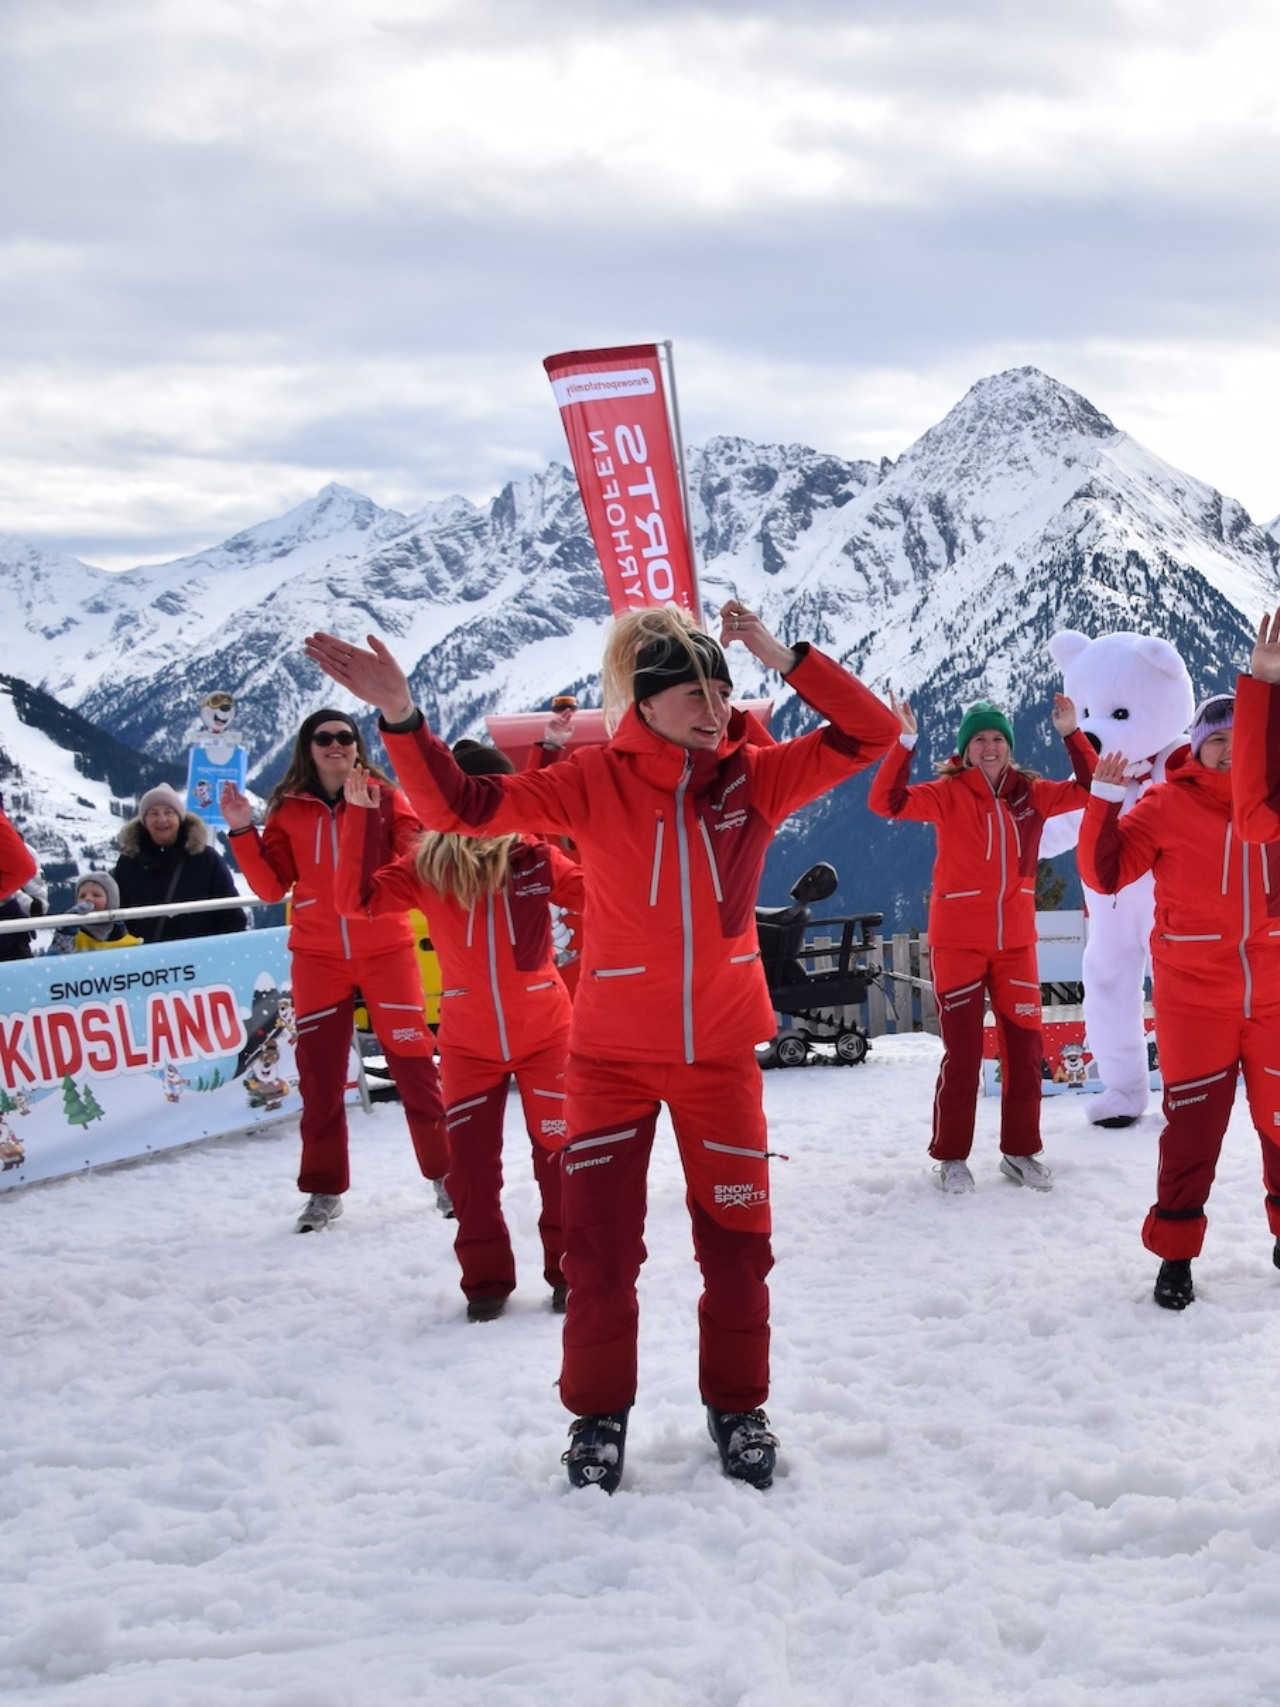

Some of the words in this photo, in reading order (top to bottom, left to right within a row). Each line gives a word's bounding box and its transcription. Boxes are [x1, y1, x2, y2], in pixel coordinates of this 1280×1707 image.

[50, 964, 196, 1001] SNOWSPORTS
[0, 990, 243, 1089] KIDSLAND
[1176, 1093, 1208, 1107] ziener
[574, 1155, 614, 1171] ziener
[714, 1183, 754, 1195] SNOW
[714, 1190, 767, 1204] SPORTS
